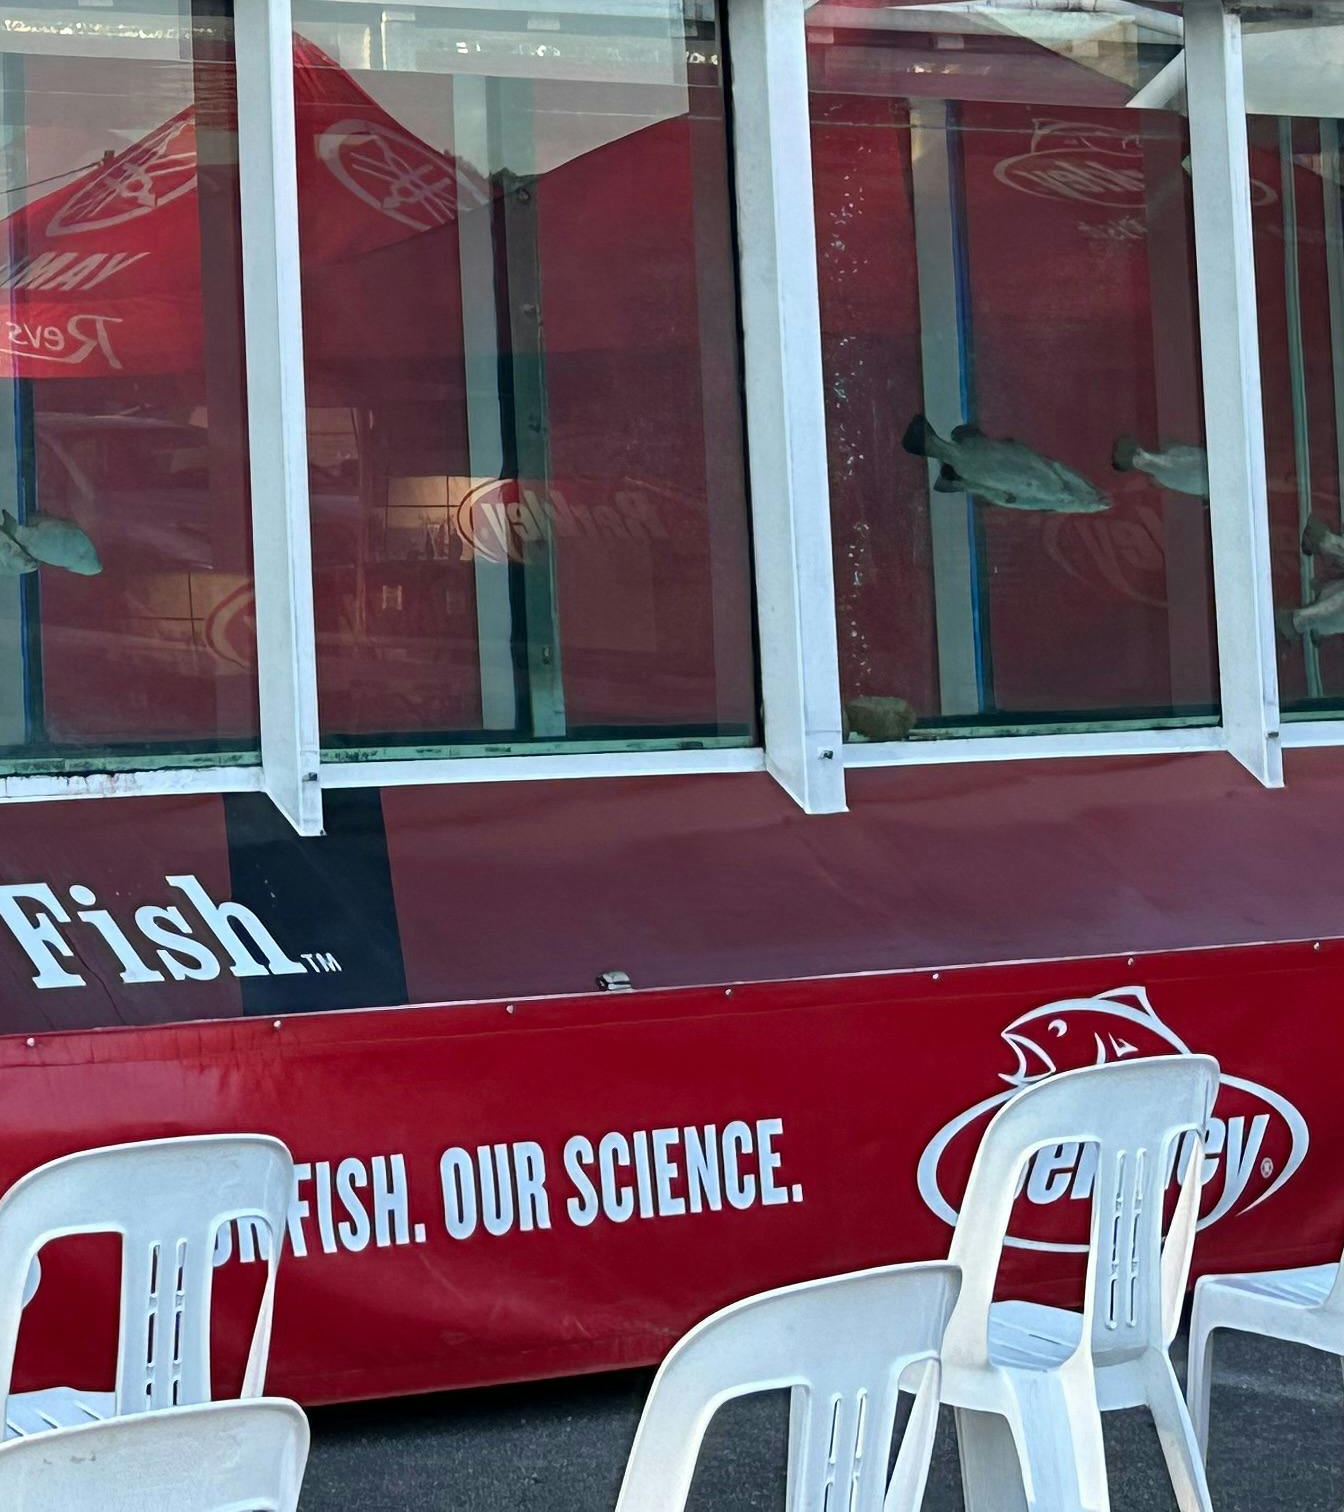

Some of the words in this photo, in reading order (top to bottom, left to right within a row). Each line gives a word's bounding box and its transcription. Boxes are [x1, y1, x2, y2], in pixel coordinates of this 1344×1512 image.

[287, 1153, 426, 1258] FISH.
[440, 1140, 553, 1241] OUR
[565, 1117, 804, 1228] SCIENCE.
